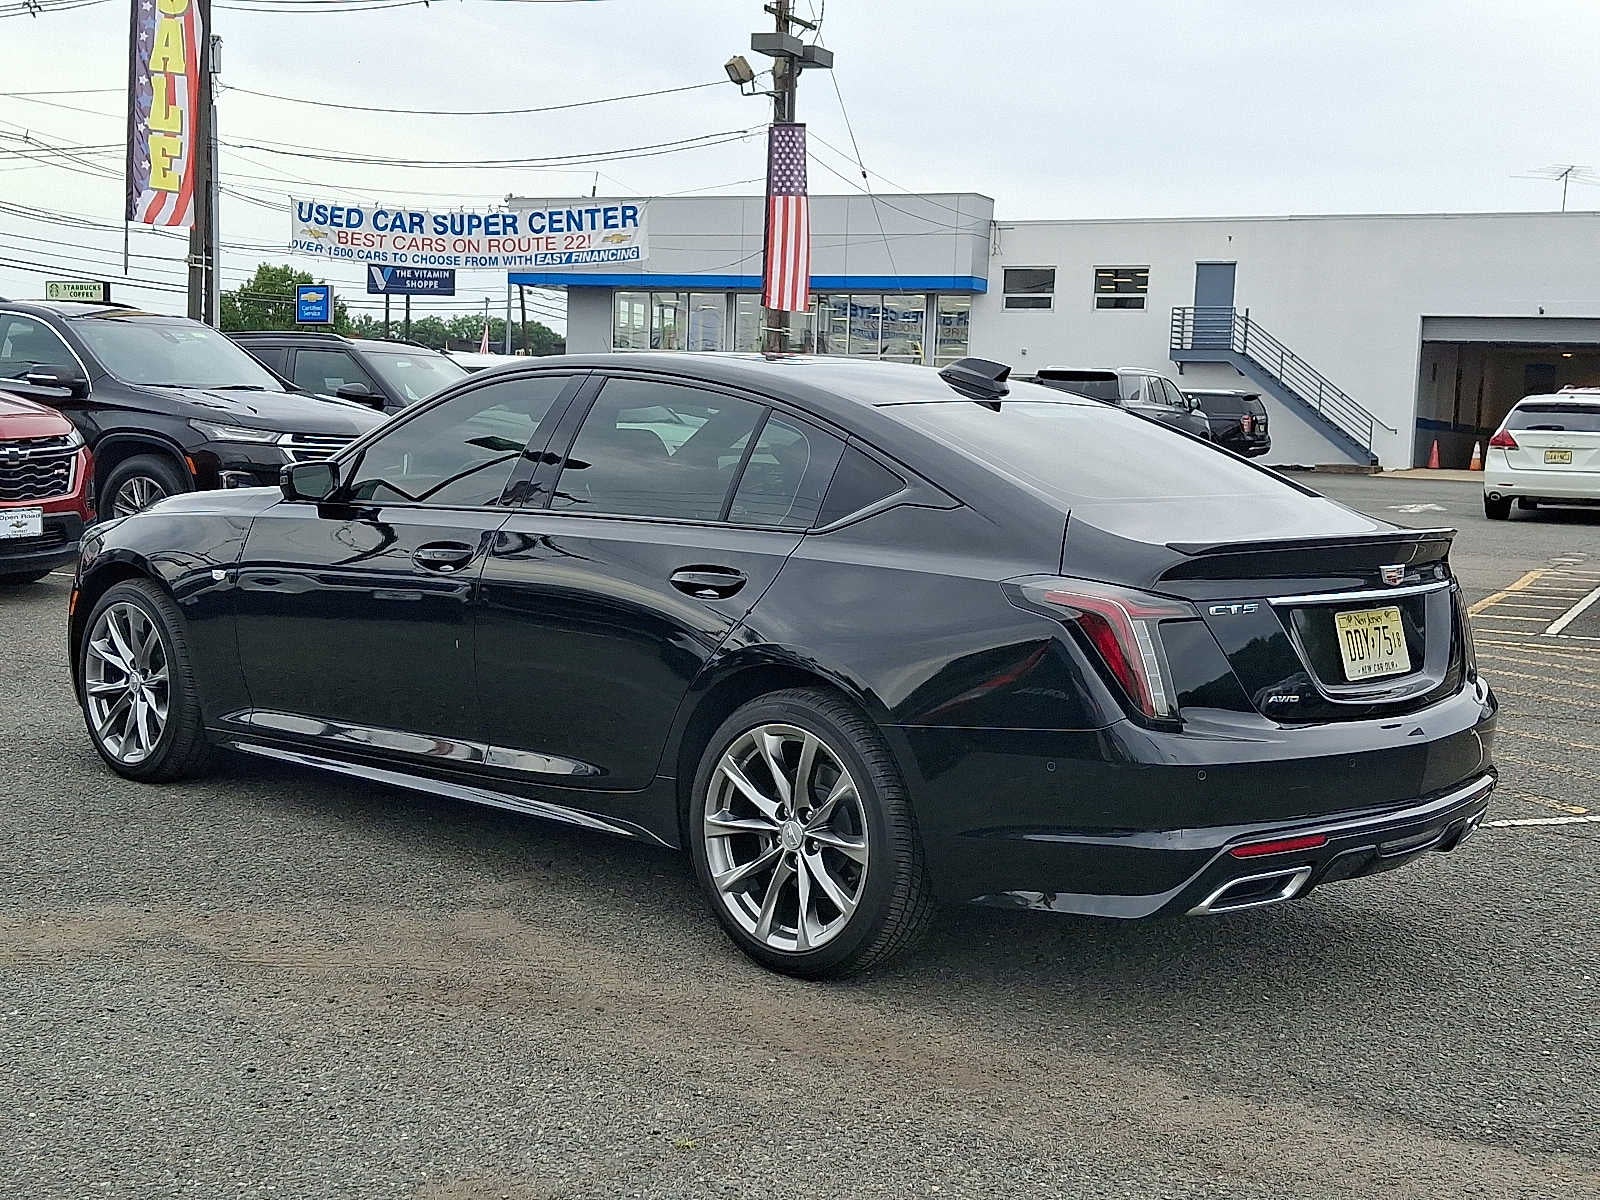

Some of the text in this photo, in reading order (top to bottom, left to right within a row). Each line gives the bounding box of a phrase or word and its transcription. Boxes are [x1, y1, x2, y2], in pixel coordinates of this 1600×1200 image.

[149, 0, 188, 193] ALE
[298, 201, 639, 236] USED CAR SUPER CENTER
[338, 230, 591, 254] BEST CARS ON ROUTE 22!
[291, 239, 639, 267] OVER 1500 CARS TO CHOOSE FROM WITH EASY FINANCING
[395, 269, 450, 279] THE VITAMIN
[405, 280, 439, 289] SHOPPE
[1209, 604, 1260, 616] CT5
[1267, 695, 1300, 704] AWD
